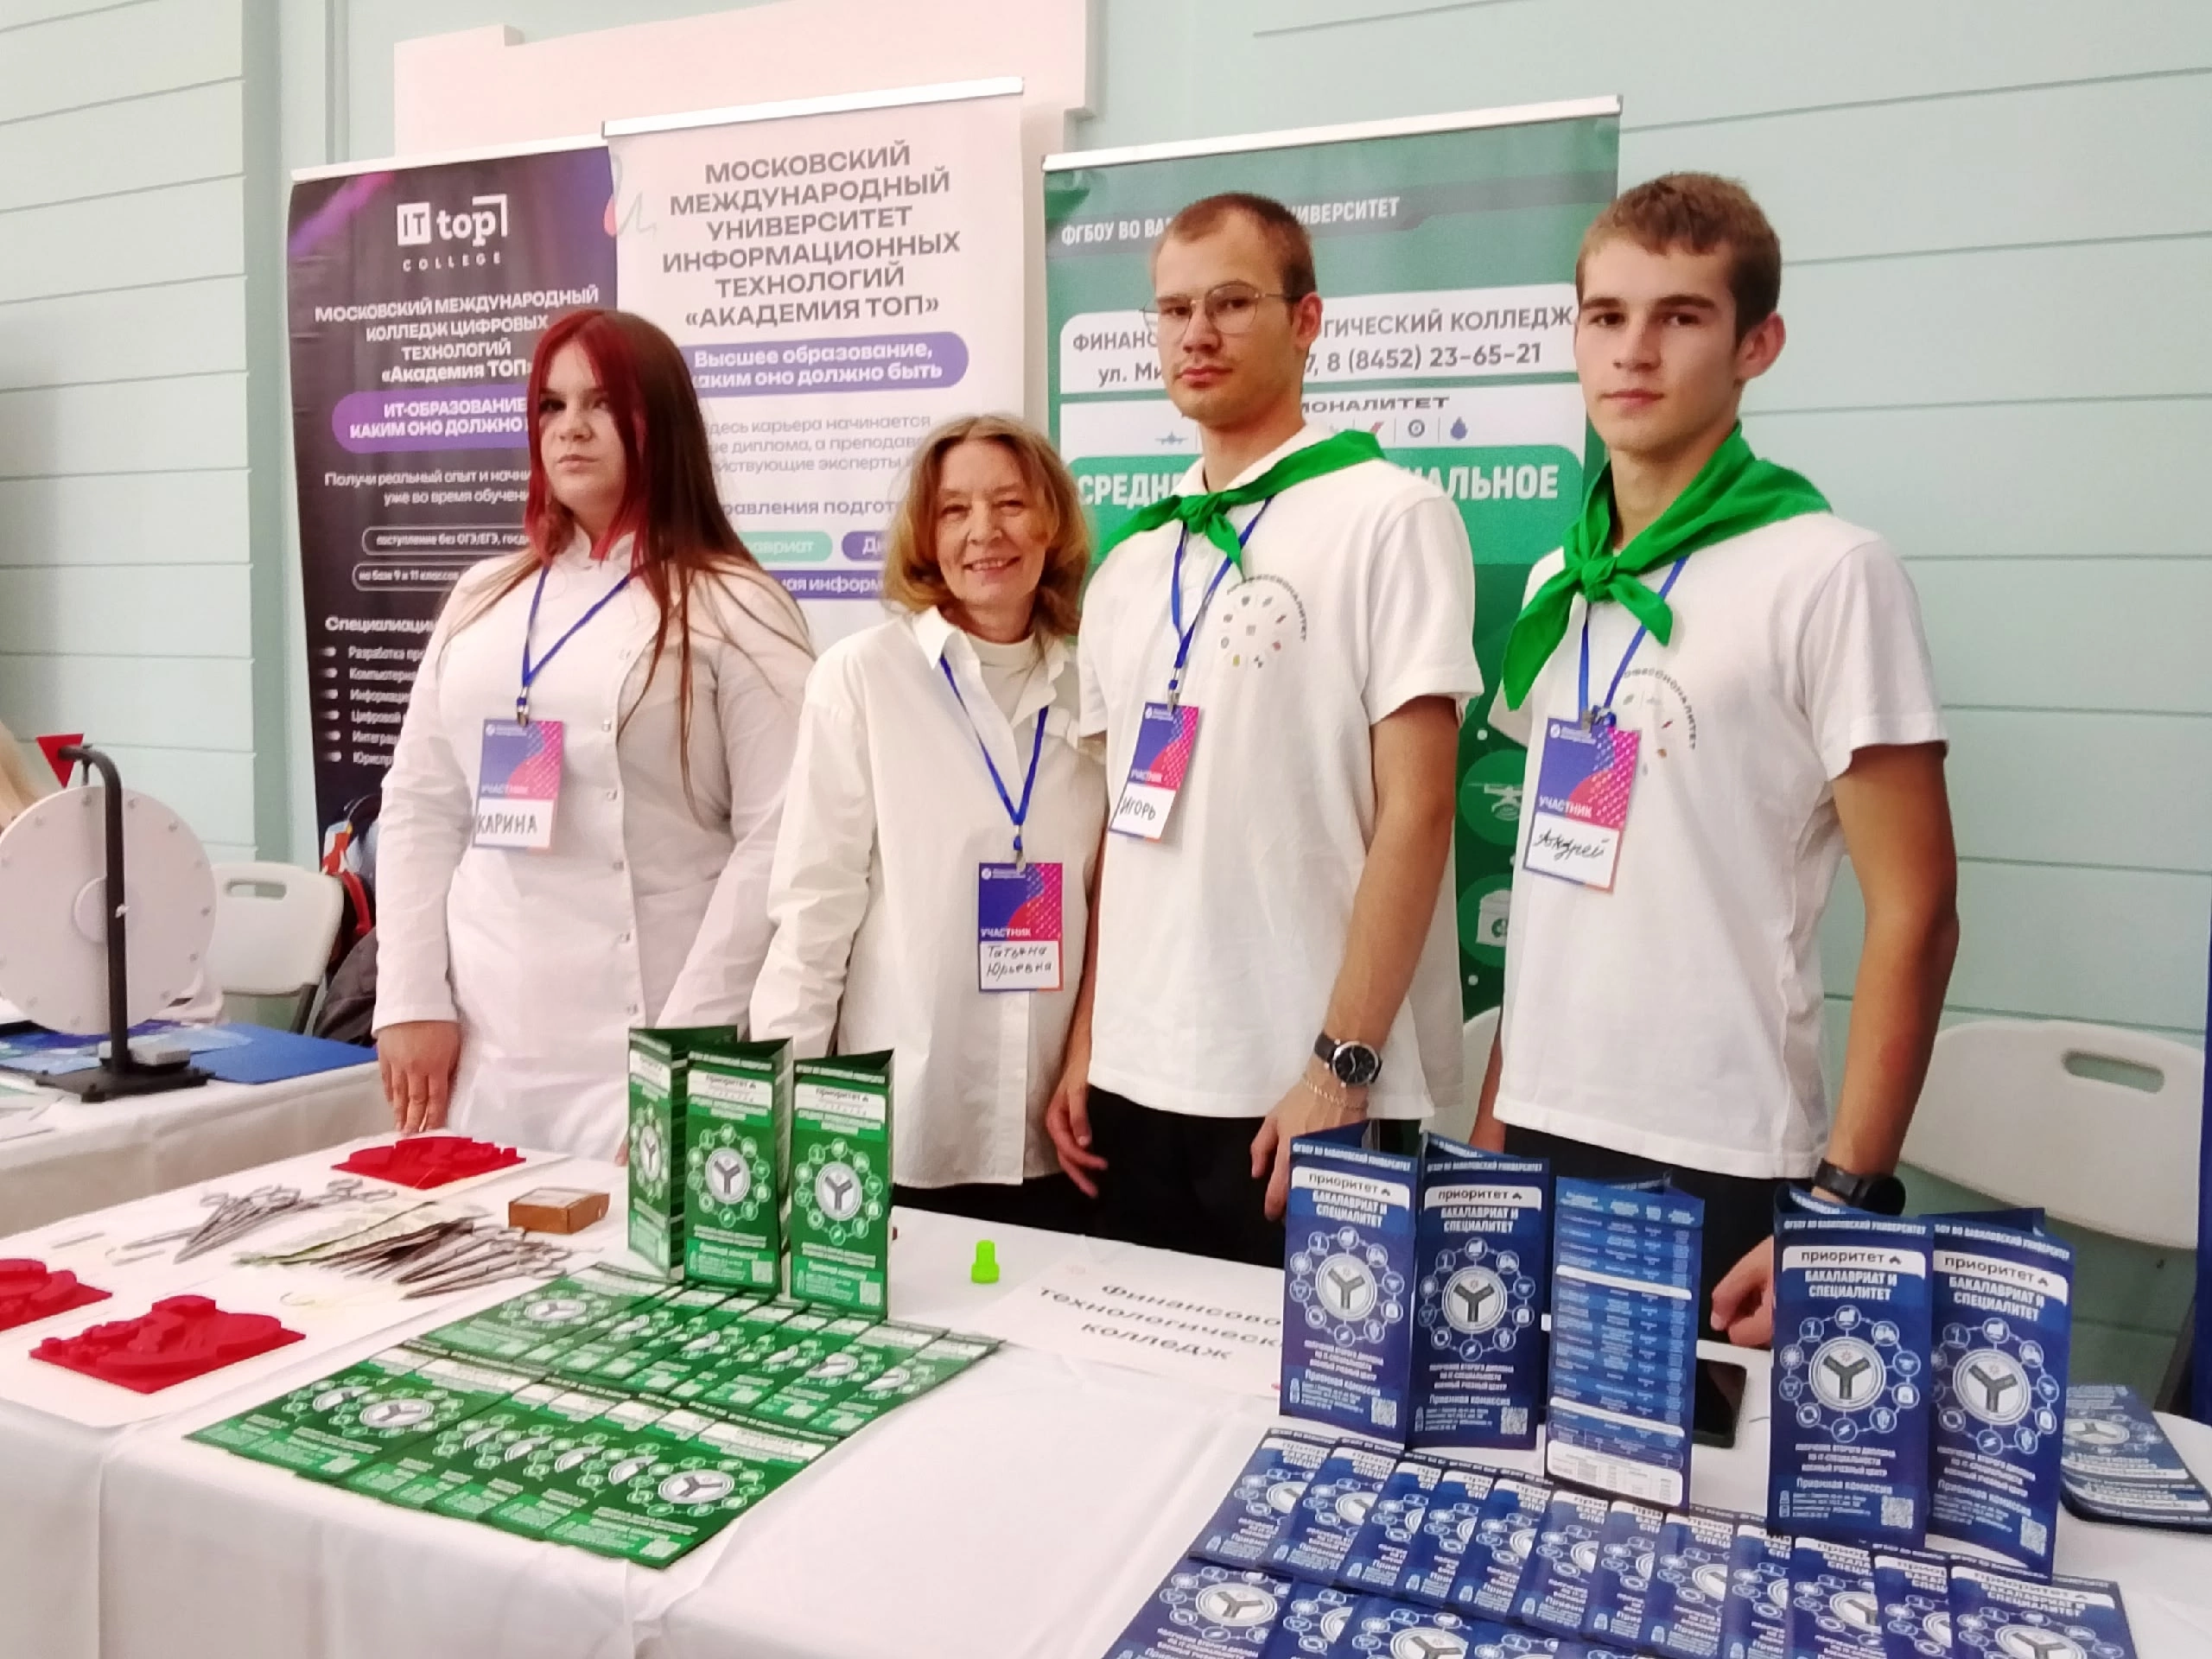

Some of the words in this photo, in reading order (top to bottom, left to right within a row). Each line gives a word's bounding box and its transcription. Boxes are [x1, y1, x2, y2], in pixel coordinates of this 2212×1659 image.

[705, 140, 912, 183] МОСКОВСКИЙ
[670, 166, 950, 215] МЕЖДУНАРОДНЫЙ
[706, 206, 913, 241] УНИВЕРСИТЕТ
[1061, 220, 1115, 245] ФГБОУ
[1118, 219, 1141, 239] ВО
[1289, 197, 1400, 226] ИВЕРСИТЕТ
[403, 251, 502, 273] COLLEGE
[663, 231, 961, 273] ИНФОРМАЦИОННЫХ
[715, 262, 905, 297] ТЕХНОЛОГИЙ
[315, 297, 432, 322] МОСКОВСКИЙ
[435, 284, 599, 316] МЕЖДУНАРОДНЫЙ
[685, 298, 860, 328] «АКАДЕМИЯ
[864, 295, 939, 318] ТОП»
[365, 322, 448, 342] КОЛЛЕДЖ
[450, 315, 550, 340] ЦИФРОВЫХ
[1323, 308, 1444, 339] ГИЧЕСКИЙ
[1451, 305, 1574, 333] КОЛЛЕДЖ
[401, 340, 512, 361] ТЕХНОЛОГИЙ
[694, 348, 779, 367] Высшее
[782, 342, 933, 365] образование,
[381, 363, 485, 384] «Академия
[755, 371, 794, 386] оно
[797, 367, 884, 387] должно
[887, 361, 943, 380] быть
[1098, 366, 1128, 387] ул.
[1327, 352, 1340, 372] 8
[1349, 344, 1421, 373] (8452)
[1429, 341, 1542, 367] 23-65-21
[349, 423, 405, 439] КАКИМ
[408, 421, 443, 437] ОНО
[446, 417, 522, 436] ДОЛЖНО
[708, 421, 748, 436] десь
[751, 417, 823, 435] карьера
[825, 416, 931, 432] начинается
[732, 440, 812, 454] диплома,
[815, 440, 825, 449] а
[715, 459, 815, 476] йствующие
[818, 456, 900, 473] эксперты
[324, 473, 377, 488] Получи
[378, 470, 442, 487] реальный
[444, 471, 477, 484] опыт
[480, 473, 489, 482] и
[384, 493, 410, 506] уже
[412, 493, 429, 503] во
[431, 492, 472, 505] время
[474, 488, 529, 505] обучени
[724, 499, 819, 518] равления
[823, 499, 893, 518] подгот
[438, 533, 455, 544] без
[809, 575, 883, 594] информ
[1120, 796, 1157, 821] ИГОРЬ
[1538, 795, 1593, 818] УЧАСТНИК
[477, 813, 538, 835] КАРИНА
[981, 926, 1032, 938] УЧАСТНИК
[1309, 1173, 1378, 1193] приоритет
[1438, 1190, 1509, 1202] приоритет
[1801, 1251, 1885, 1265] приоритет
[1944, 1256, 2035, 1283] приоритет
[1804, 1270, 1886, 1285] БАКАЛАВРИАТ
[1808, 1285, 1891, 1300] СПЕЦИАЛИТЕТ
[1949, 1276, 2034, 1305] БАКАЛАВРИАТ
[1102, 1285, 1281, 1326] Финансово
[1954, 1292, 2039, 1322] СПЕЦИАЛИТЕТ
[1040, 1287, 1282, 1349] технологическ
[1082, 1323, 1233, 1359] колледж
